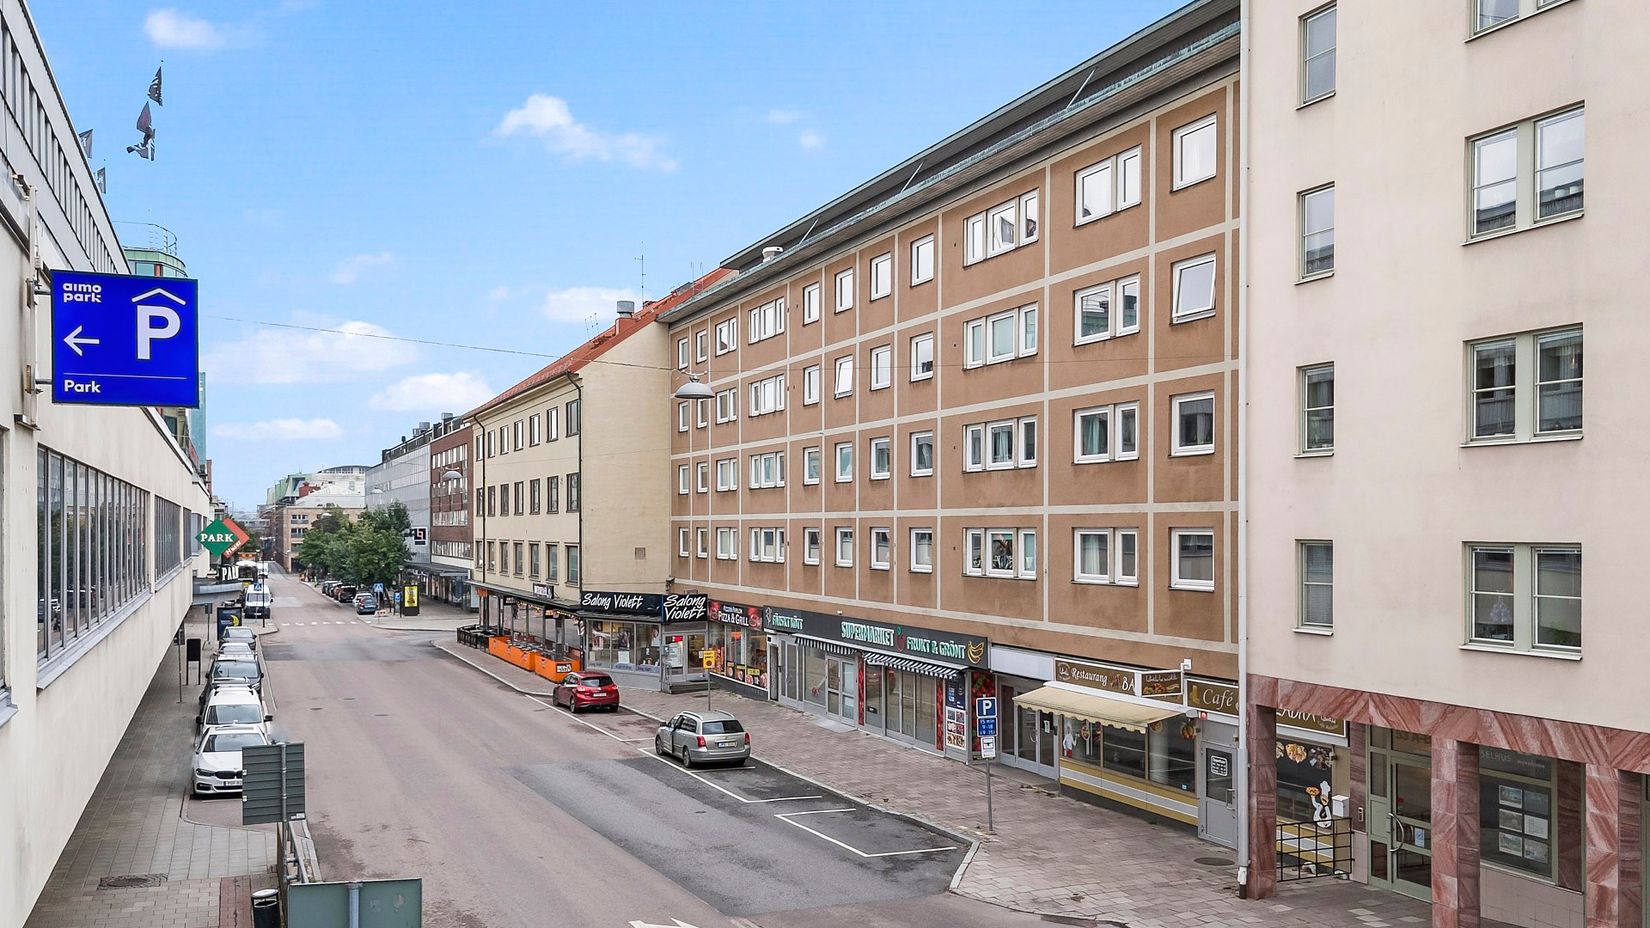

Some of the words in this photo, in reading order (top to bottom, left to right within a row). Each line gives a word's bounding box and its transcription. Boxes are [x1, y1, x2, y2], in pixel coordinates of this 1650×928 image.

[63, 282, 102, 292] aimo
[63, 292, 102, 303] park
[136, 304, 181, 360] P
[64, 379, 101, 393] Park
[200, 533, 234, 542] PARK
[582, 593, 612, 610] Salong
[613, 594, 644, 609] Violett
[663, 594, 706, 609] Salong
[664, 606, 707, 620] Violett
[841, 621, 895, 647] SUPERMARKET
[906, 636, 931, 652] FRUKT
[939, 640, 966, 660] GRÖNT
[1071, 667, 1108, 688] Restaurang
[1202, 687, 1233, 711] Café
[983, 700, 992, 715] P
